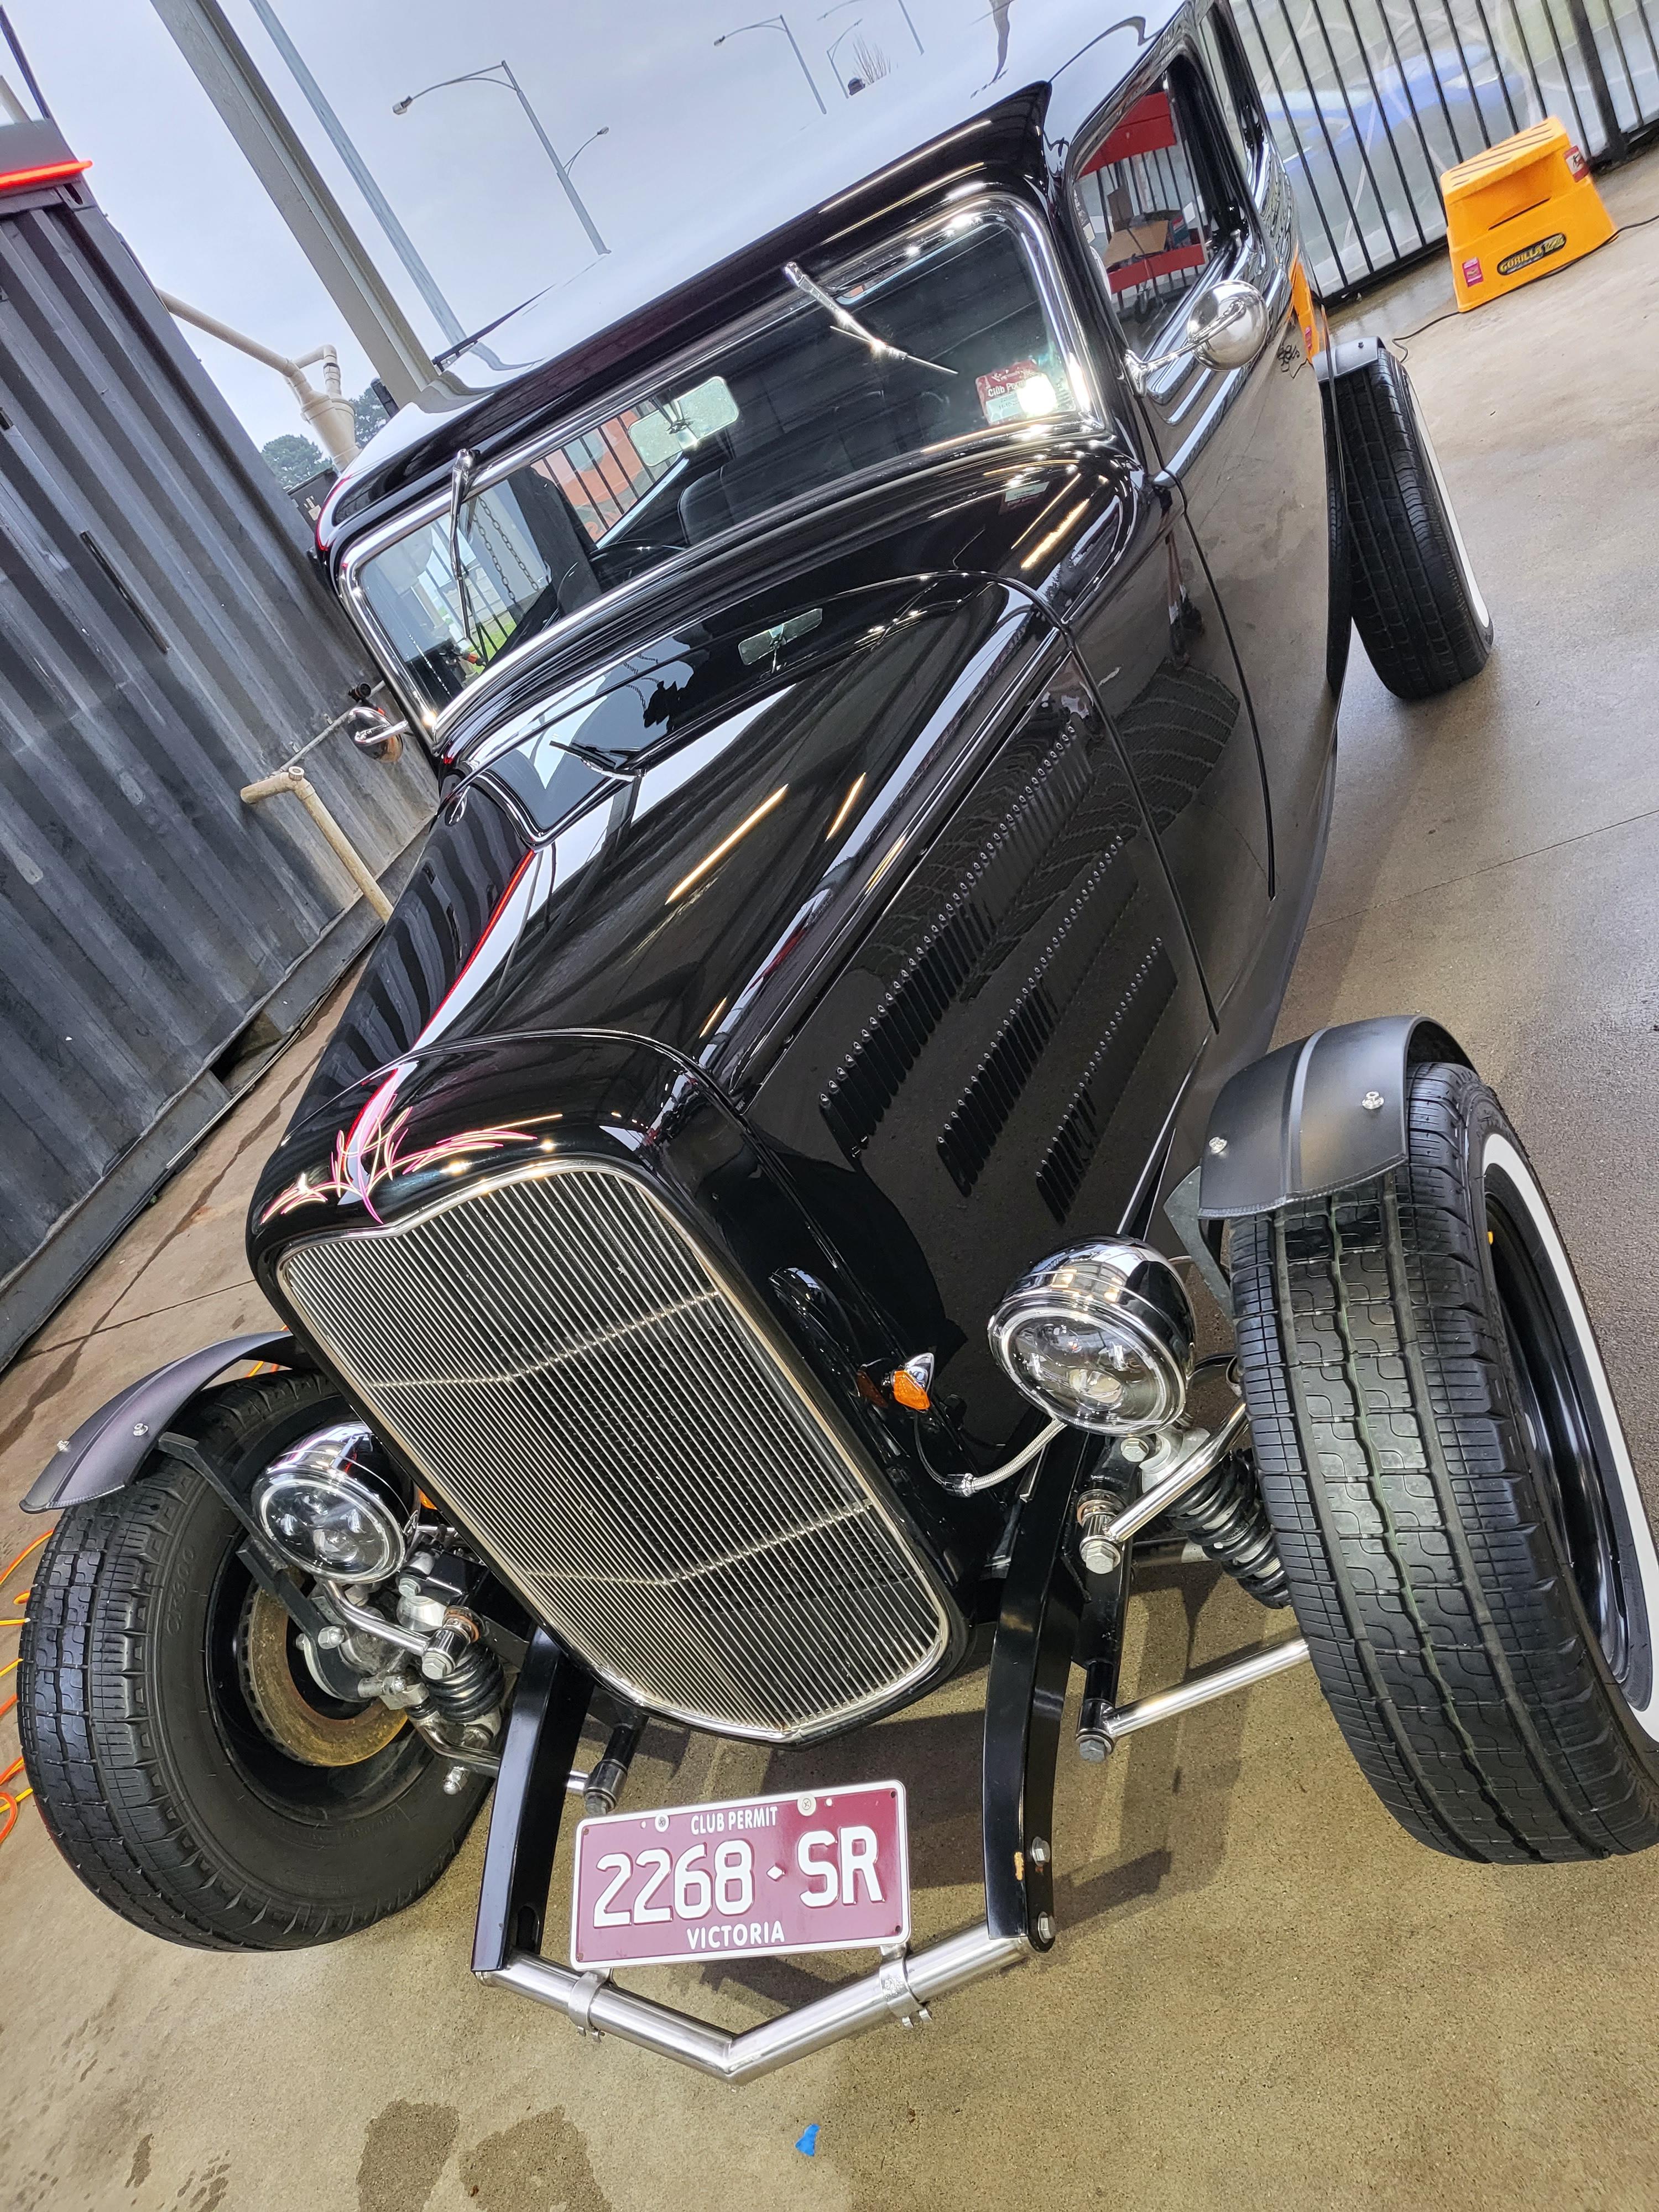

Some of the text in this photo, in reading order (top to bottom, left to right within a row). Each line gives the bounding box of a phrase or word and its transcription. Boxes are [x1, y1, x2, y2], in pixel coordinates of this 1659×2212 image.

[1499, 245, 1542, 272] GORILLA
[690, 1806, 778, 1835] CLUB PERMIT
[593, 1825, 886, 1928] 2268 SR
[686, 1920, 785, 1950] VICTORIA
